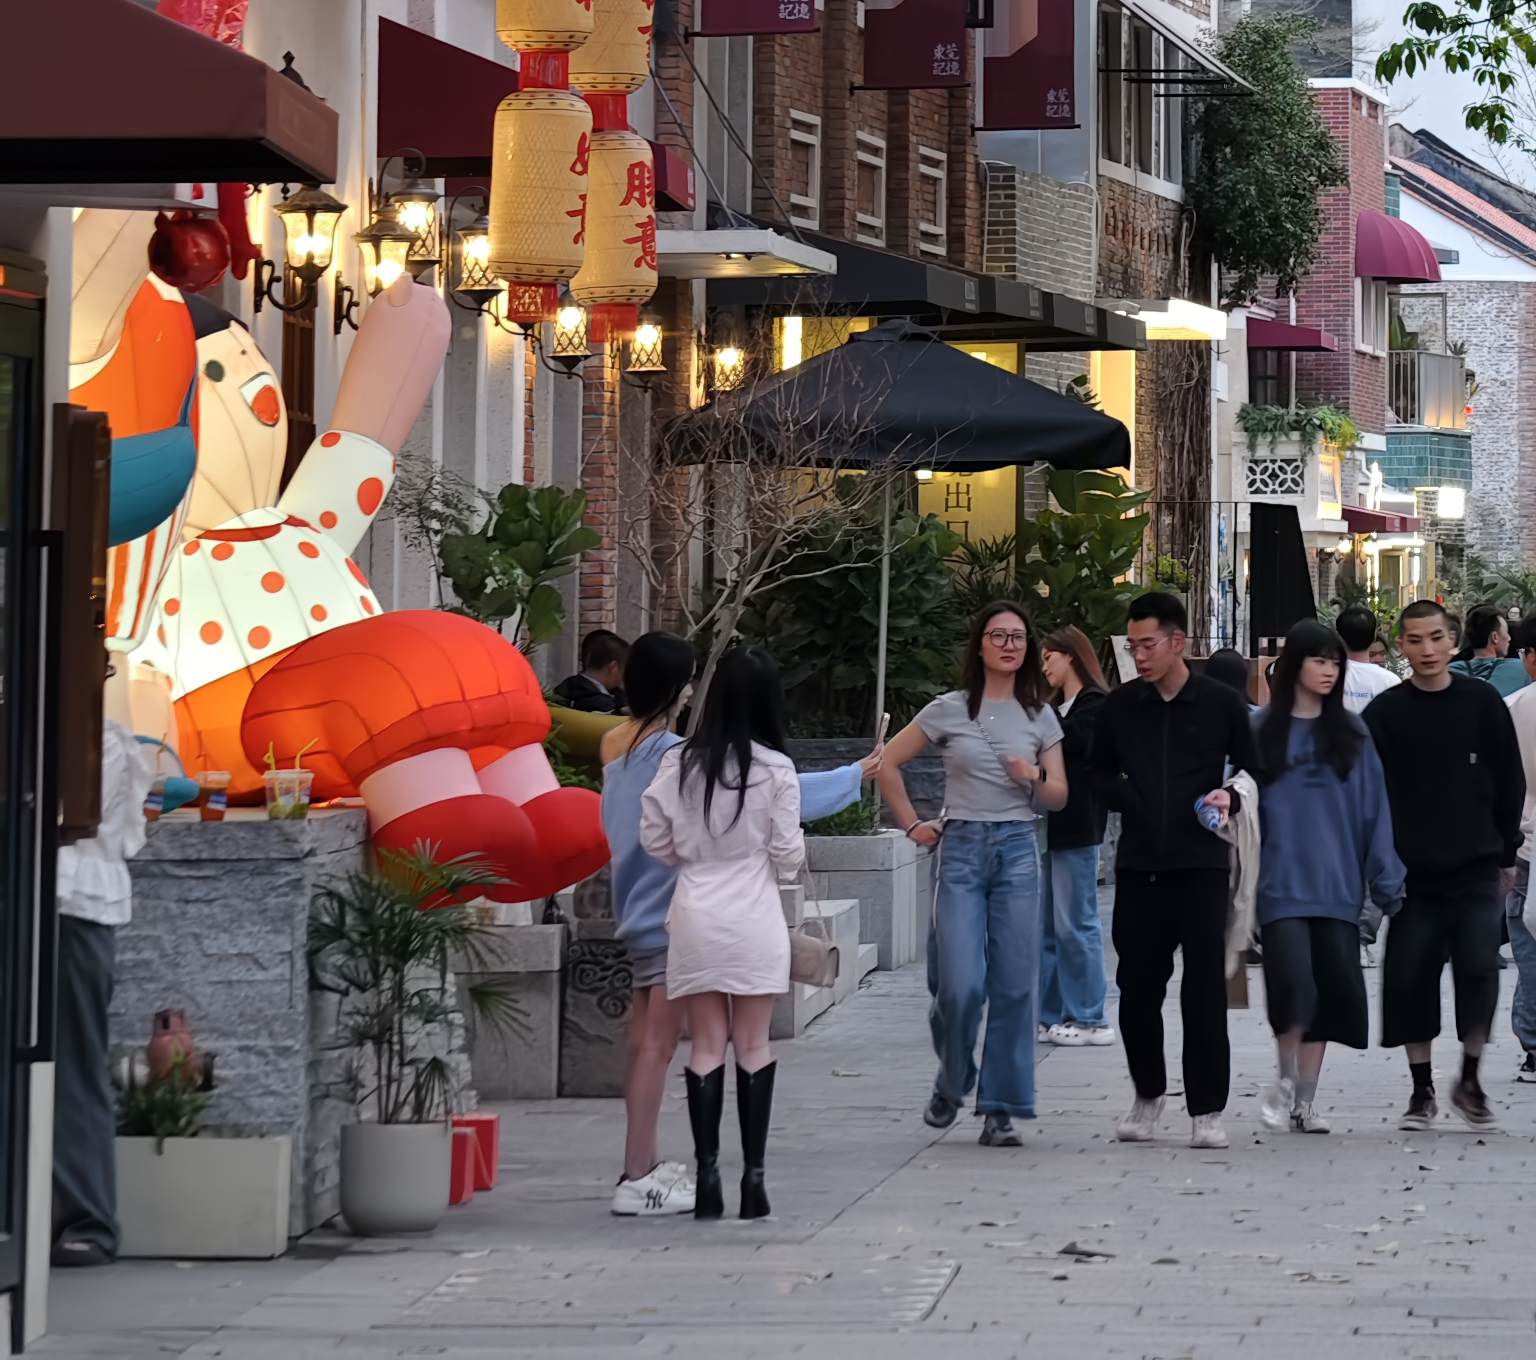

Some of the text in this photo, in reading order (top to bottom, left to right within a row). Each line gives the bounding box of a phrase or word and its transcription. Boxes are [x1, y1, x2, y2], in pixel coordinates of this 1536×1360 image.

[778, 3, 811, 20] 記憶
[932, 43, 960, 61] 東莞
[932, 61, 961, 76] 記憶
[1047, 88, 1071, 104] 東莞
[943, 472, 973, 543] 出口
